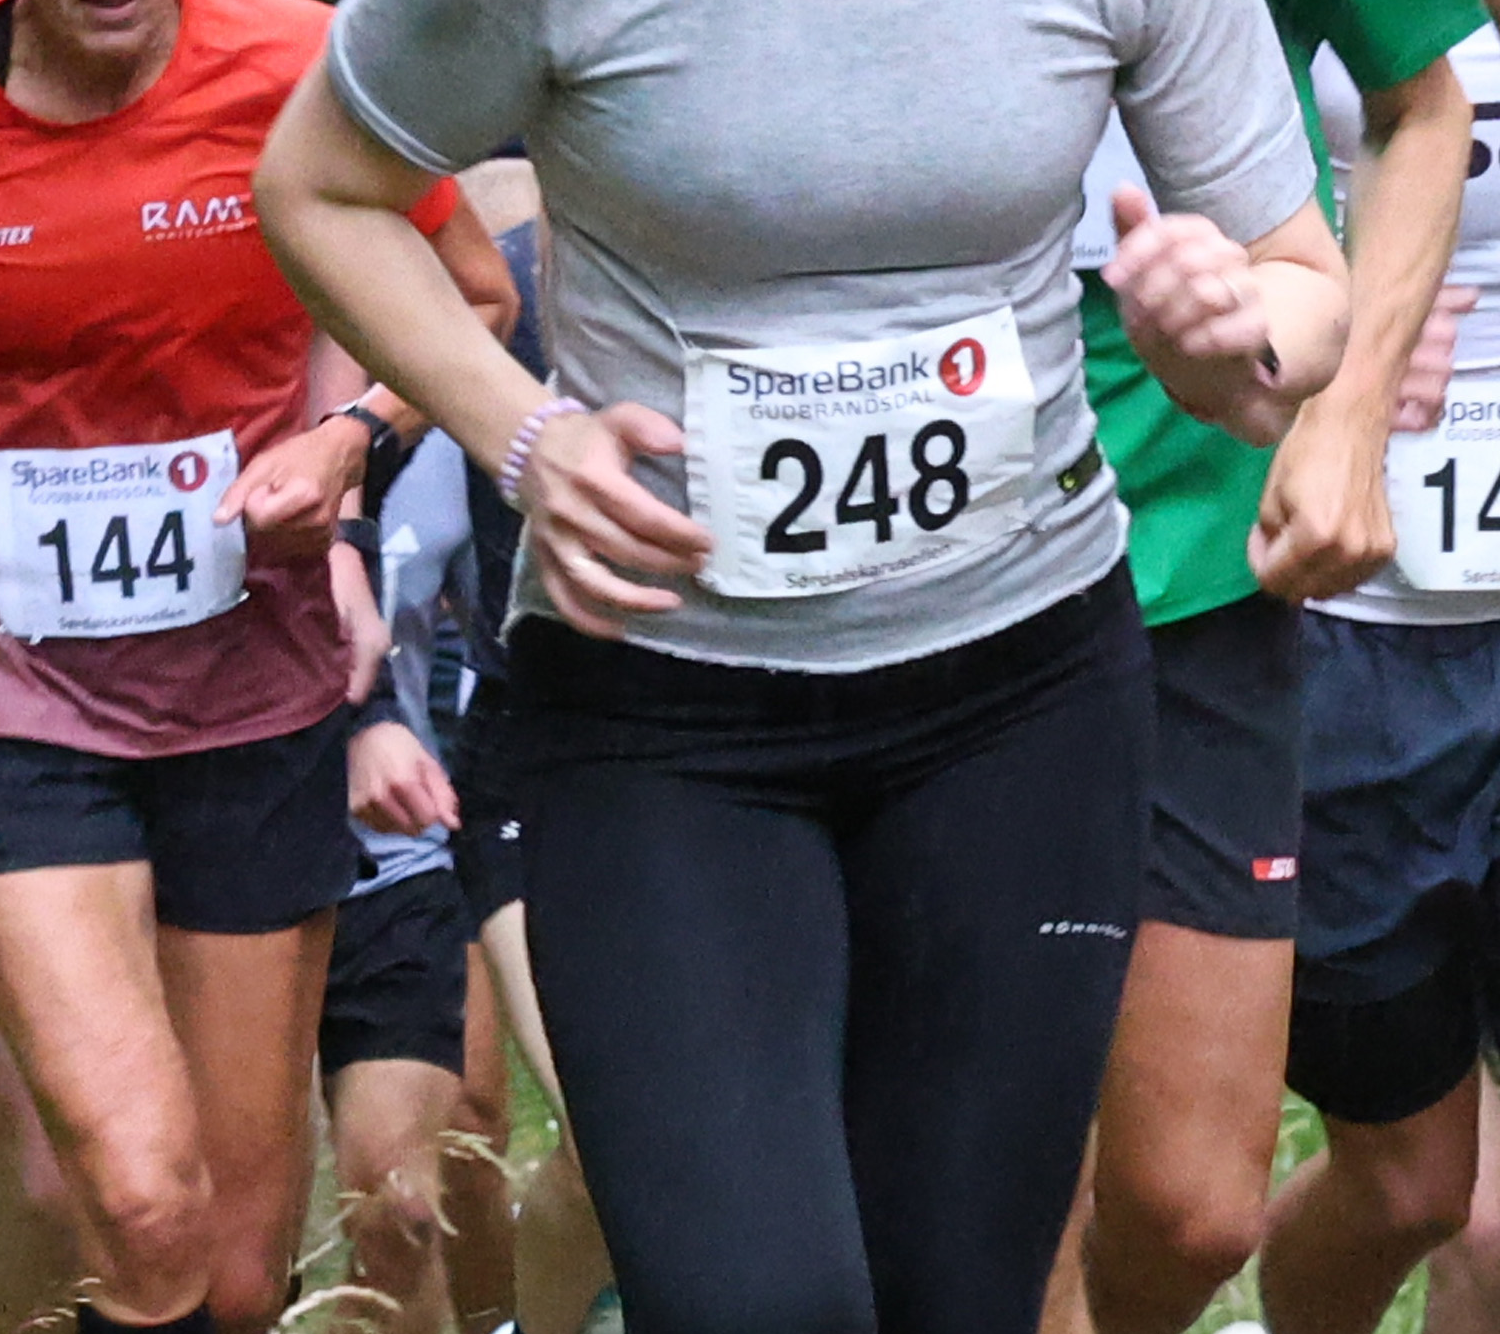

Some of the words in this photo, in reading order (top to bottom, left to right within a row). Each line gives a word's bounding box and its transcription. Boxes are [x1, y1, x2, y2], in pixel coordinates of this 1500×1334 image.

[728, 353, 930, 401] SpareBank
[12, 457, 164, 491] SpareBank
[760, 419, 969, 554] 248
[38, 510, 195, 604] 144
